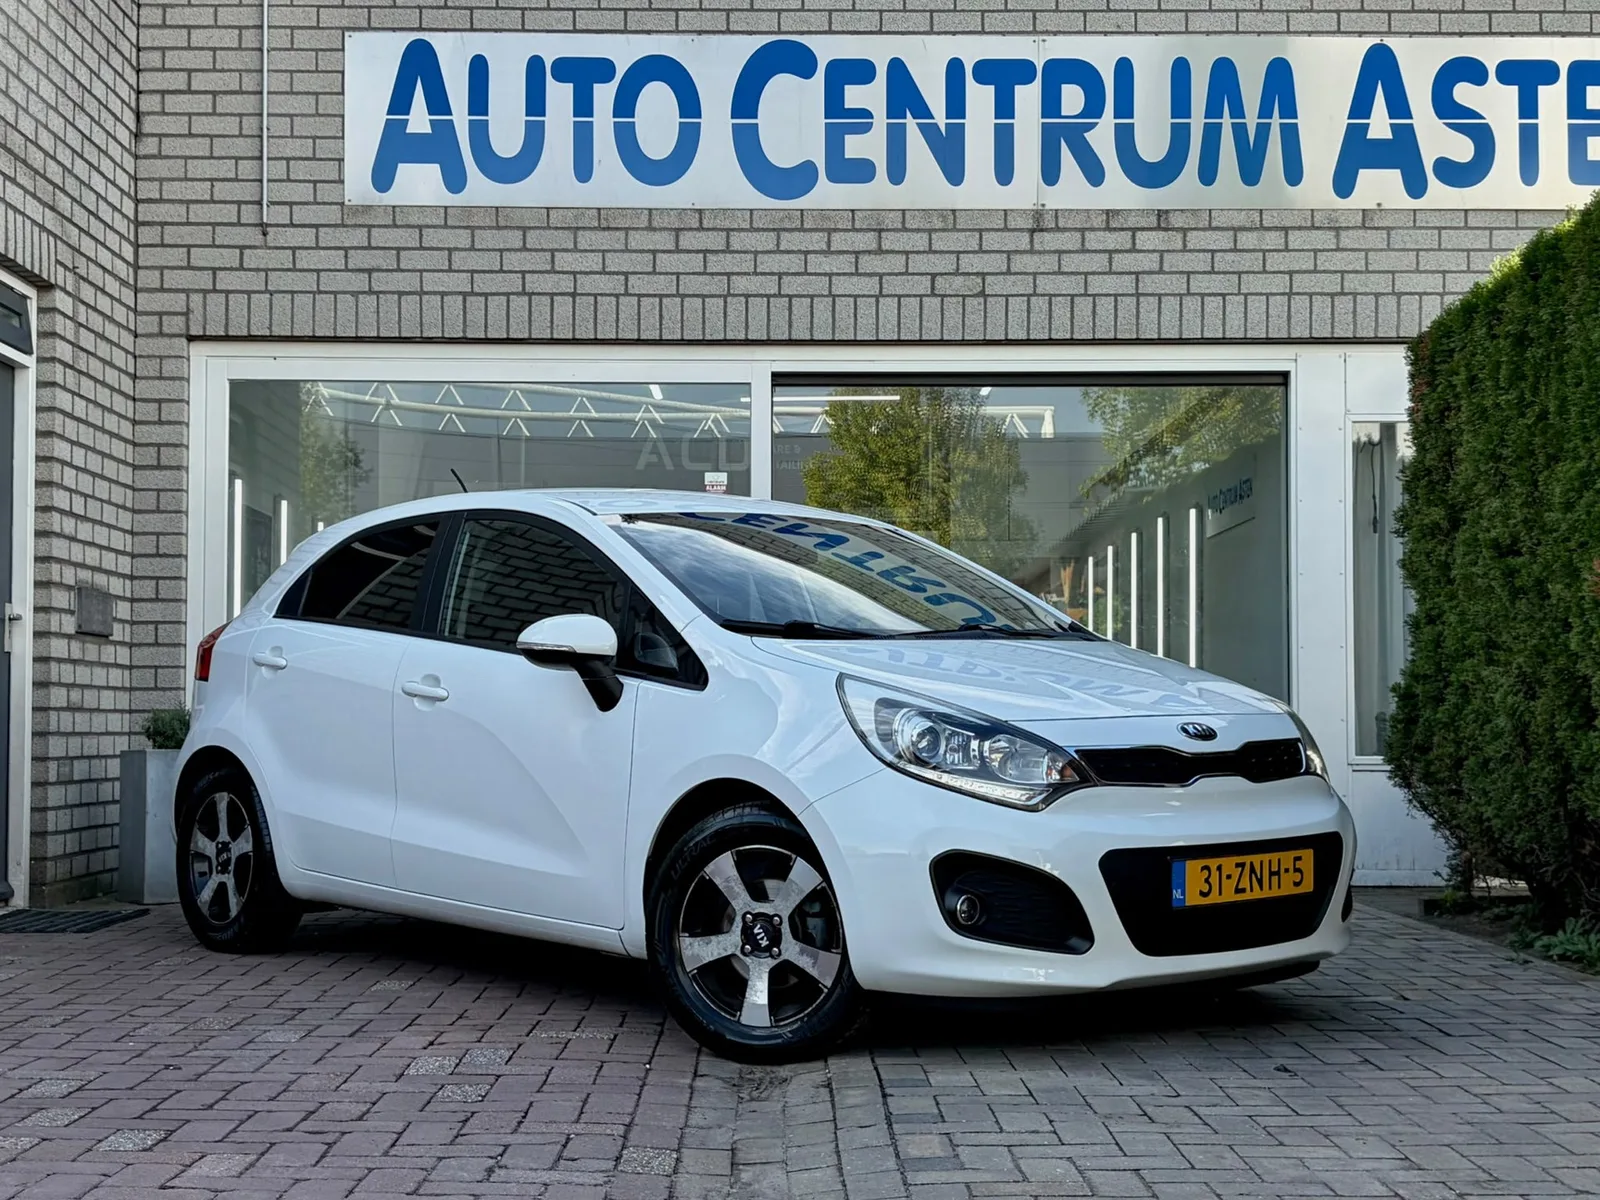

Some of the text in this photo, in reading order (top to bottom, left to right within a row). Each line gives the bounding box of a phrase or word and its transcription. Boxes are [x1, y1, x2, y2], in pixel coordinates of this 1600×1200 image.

[371, 38, 702, 195] AUTO
[730, 39, 1304, 201] CENTRUM
[1183, 723, 1215, 736] KIA
[1199, 855, 1304, 898] 31-ZNH-5
[1172, 888, 1184, 900] NL
[753, 924, 770, 948] KIA
